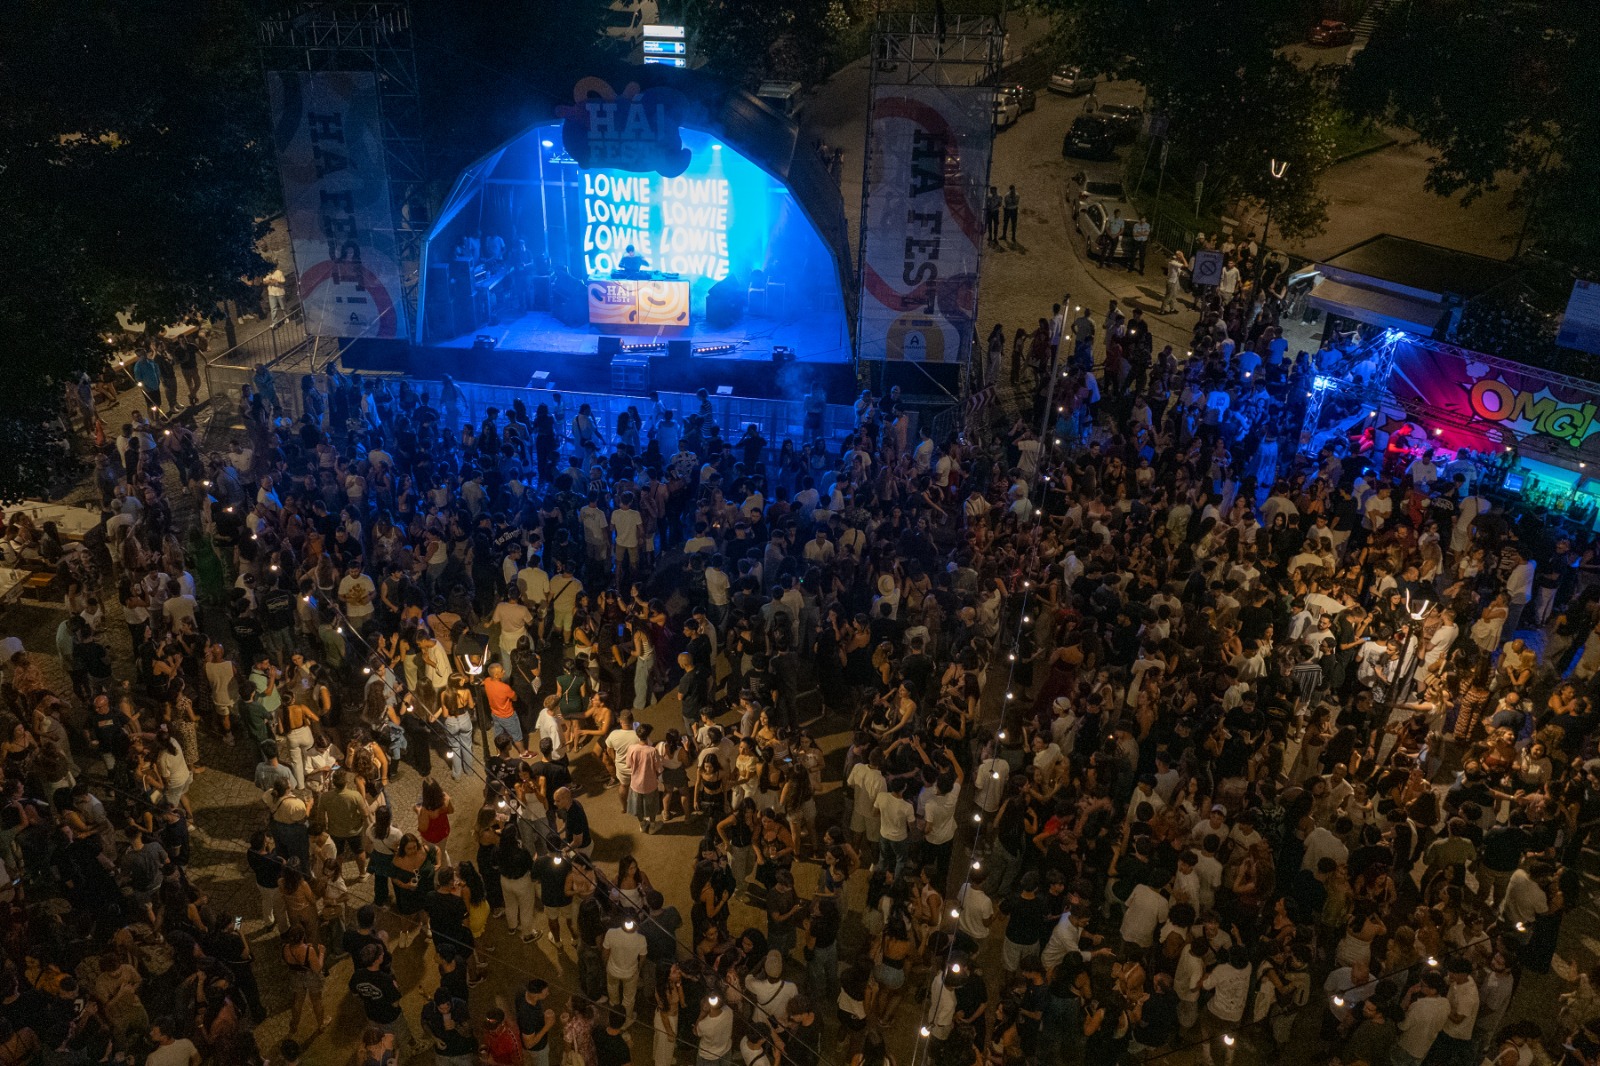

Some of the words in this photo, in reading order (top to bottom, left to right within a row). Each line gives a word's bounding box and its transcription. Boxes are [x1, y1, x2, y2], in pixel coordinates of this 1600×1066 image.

[584, 173, 650, 204] LOWIE
[662, 176, 728, 206] LOWIE
[584, 198, 650, 229] LOWIE
[662, 200, 728, 231] LOWIE
[583, 224, 652, 255] LOWIE
[659, 226, 729, 258] LOWIE
[1470, 378, 1598, 448] OMG!
